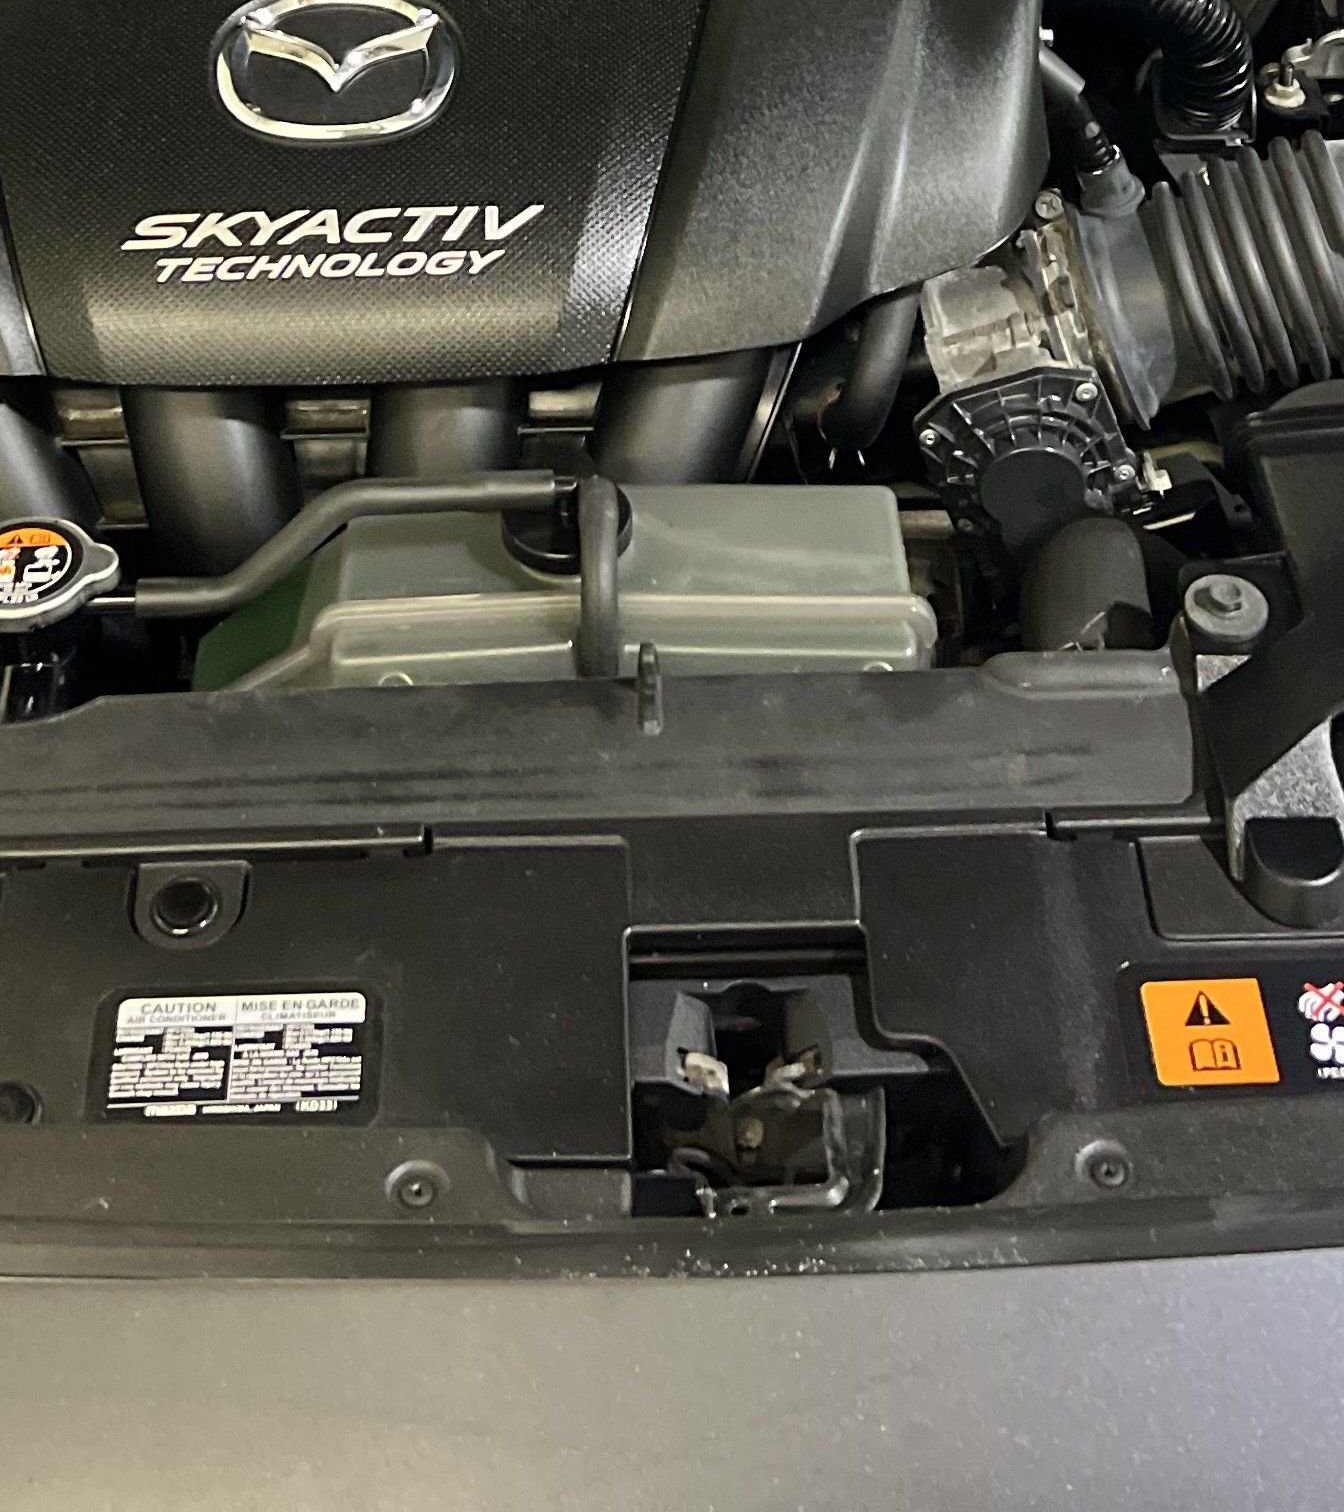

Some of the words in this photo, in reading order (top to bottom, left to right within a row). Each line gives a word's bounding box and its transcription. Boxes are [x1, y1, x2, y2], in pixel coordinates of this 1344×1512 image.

[120, 203, 545, 251] SKYACTIV
[156, 249, 506, 283] TECHNOLOGY
[141, 1002, 217, 1015] CAUTION
[242, 999, 277, 1011] MISE
[282, 999, 302, 1010] EN
[306, 998, 360, 1009] GARDE
[127, 1016, 145, 1024] AIR
[149, 1013, 226, 1024] CONDITIONER
